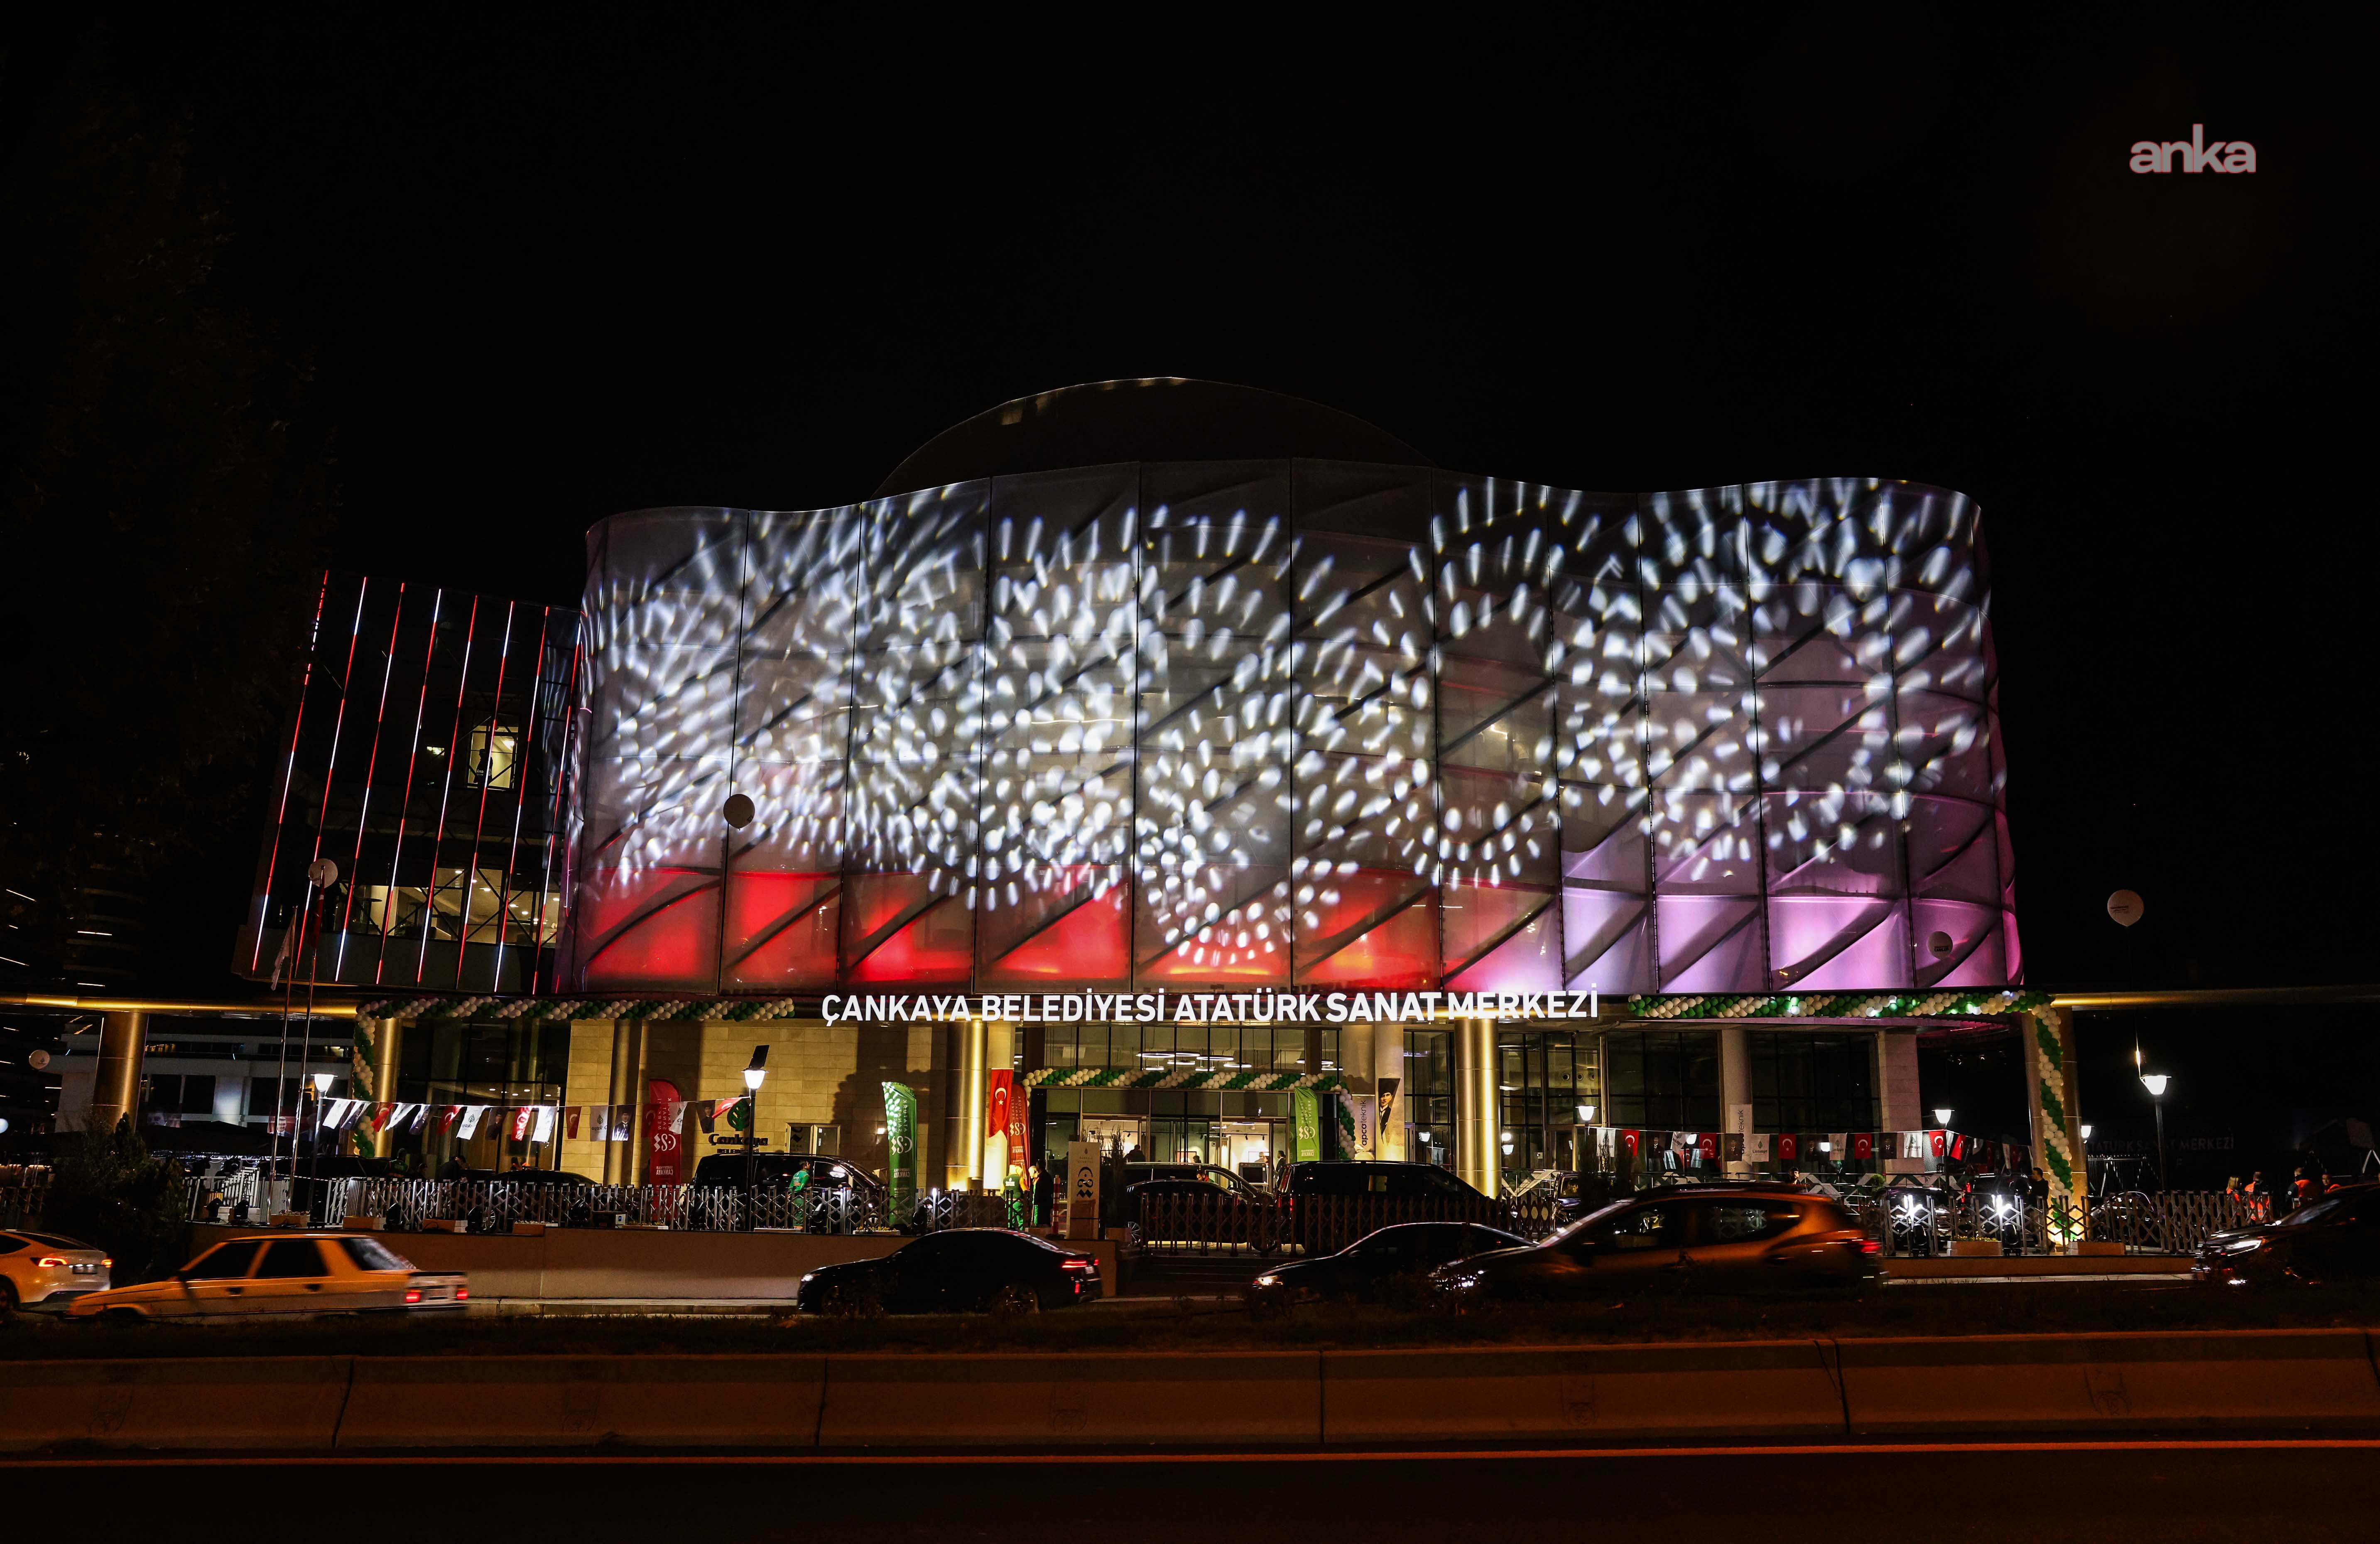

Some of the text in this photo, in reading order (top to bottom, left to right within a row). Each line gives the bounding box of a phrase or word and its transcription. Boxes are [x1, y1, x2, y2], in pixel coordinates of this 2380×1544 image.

[822, 983, 1598, 1027] ÇANKAYA BELEDİYESİ ATATÜRK SANAT MERKEZİ
